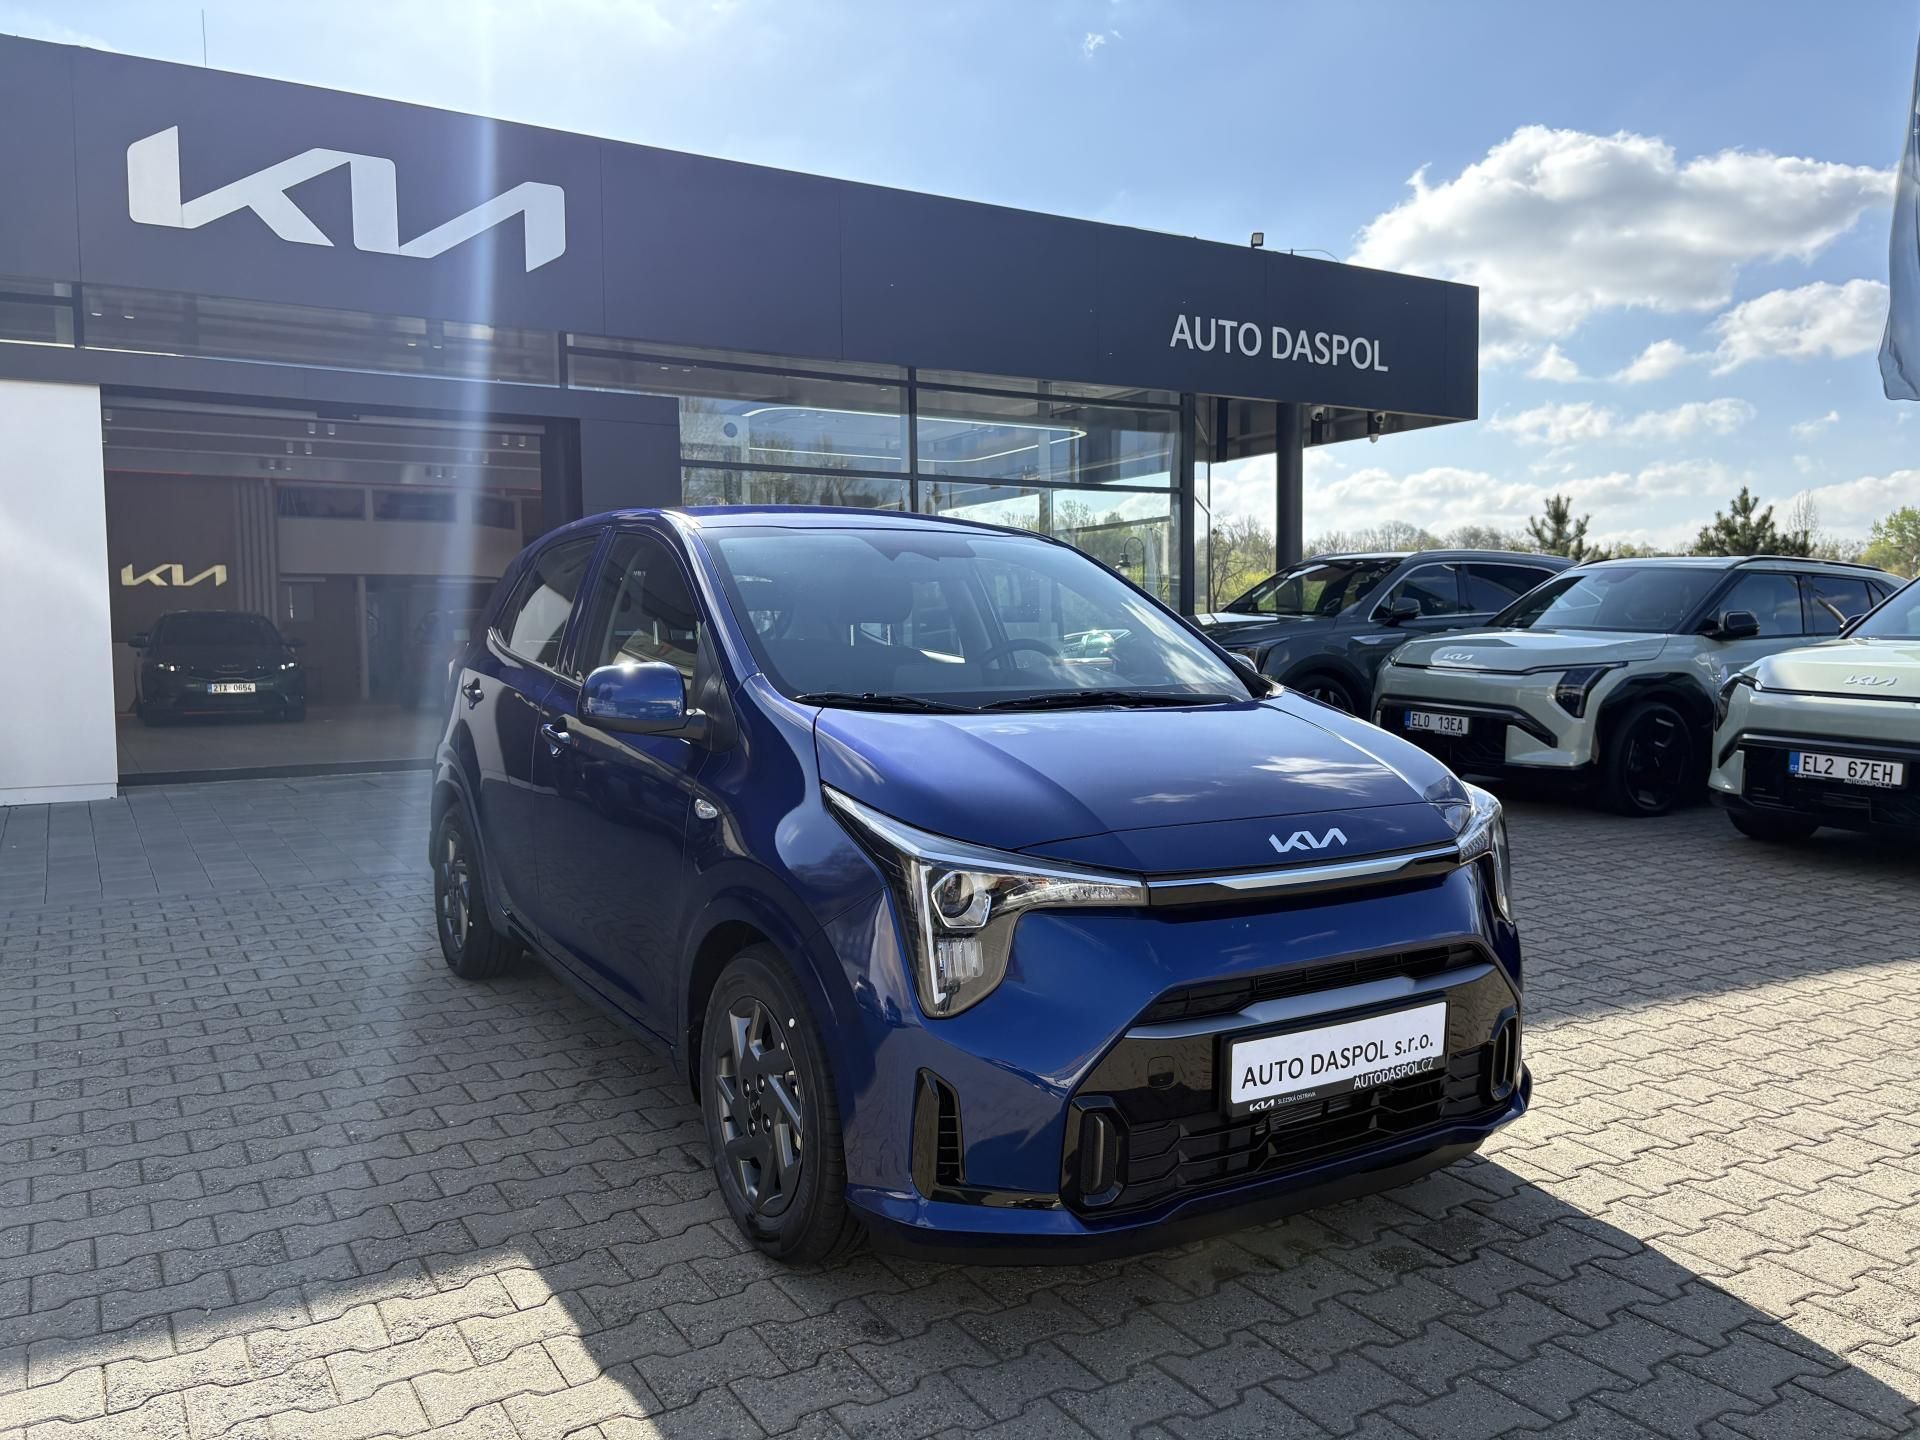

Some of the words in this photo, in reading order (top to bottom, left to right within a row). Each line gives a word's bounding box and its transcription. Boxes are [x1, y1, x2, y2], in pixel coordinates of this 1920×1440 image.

[1169, 314, 1262, 357] AUTO
[1271, 326, 1389, 372] DASPOL
[1438, 716, 1463, 732] 13EA
[1803, 755, 1835, 775] EL2
[1847, 761, 1894, 783] 67EH
[1241, 1057, 1304, 1090] AUTO
[1310, 1040, 1389, 1075] DASPOL
[1394, 1033, 1434, 1056] s.r.o.
[1352, 1057, 1435, 1090] AUTODASPOL.CZ
